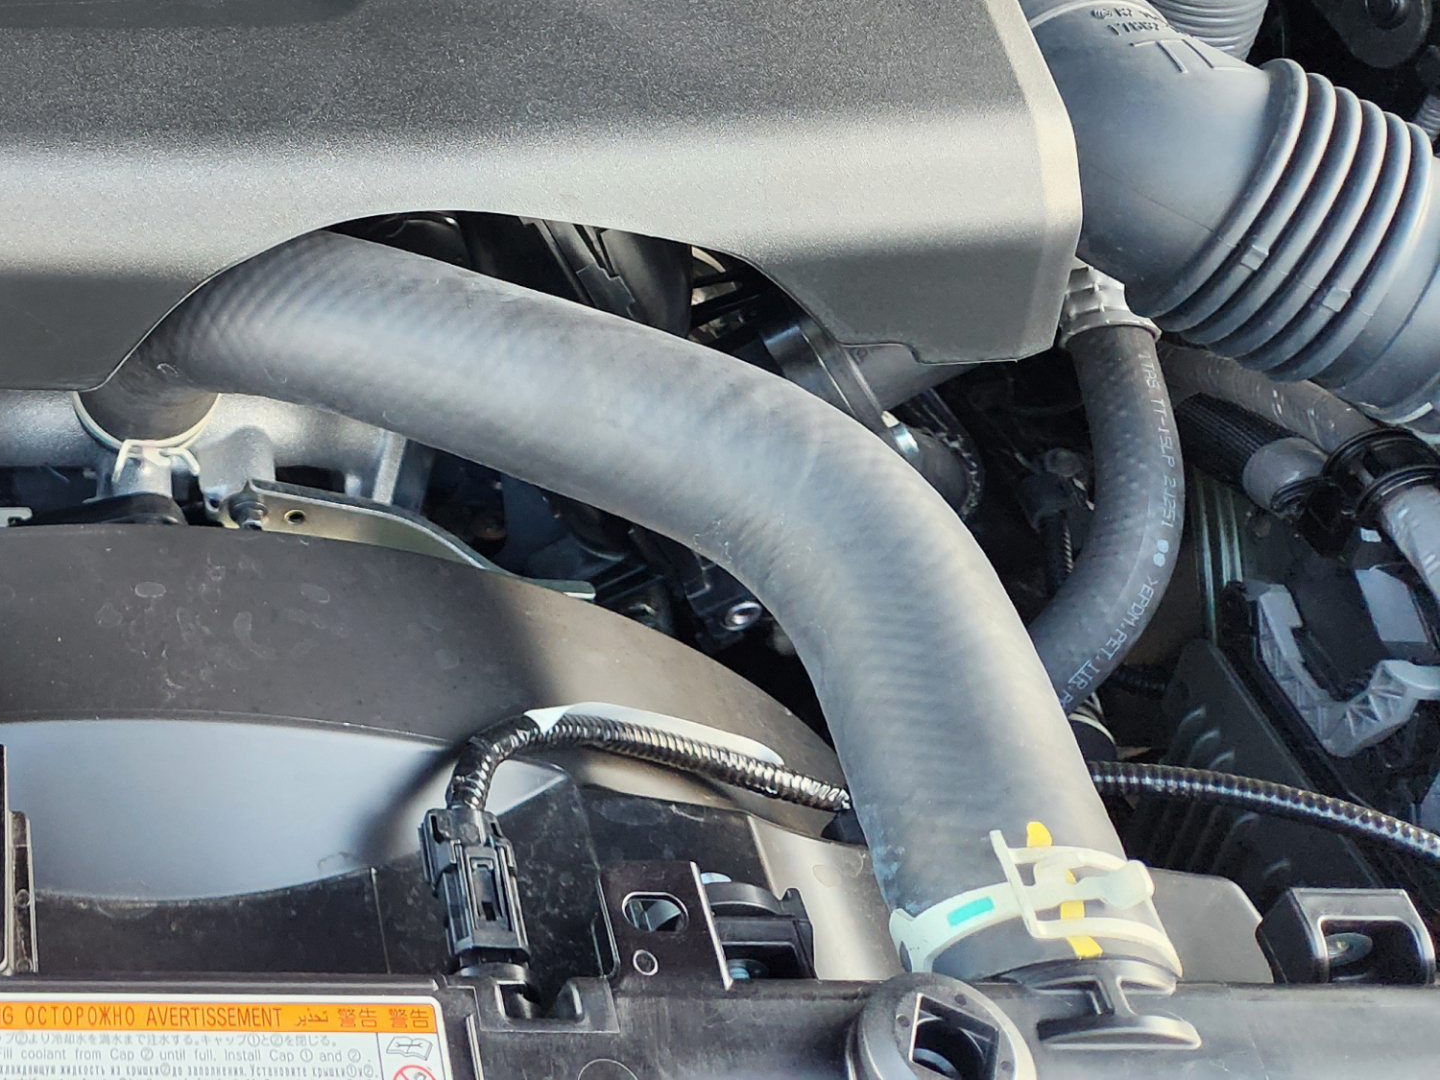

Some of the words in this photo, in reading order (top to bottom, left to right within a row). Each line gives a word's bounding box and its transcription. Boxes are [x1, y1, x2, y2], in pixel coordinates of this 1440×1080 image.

[25, 1006, 136, 1027] ОСТОРОЖНО
[146, 1007, 282, 1027] AVERTISSEMENT
[296, 1007, 329, 1027] تحذير
[338, 1008, 378, 1029] 警告
[388, 1008, 430, 1029] 警告
[21, 1047, 66, 1061] coolant
[75, 1048, 102, 1061] from
[110, 1048, 135, 1062] Cap
[159, 1048, 186, 1062] until
[224, 1049, 261, 1062] Install
[269, 1049, 295, 1063] Cap
[319, 1049, 343, 1062] and
